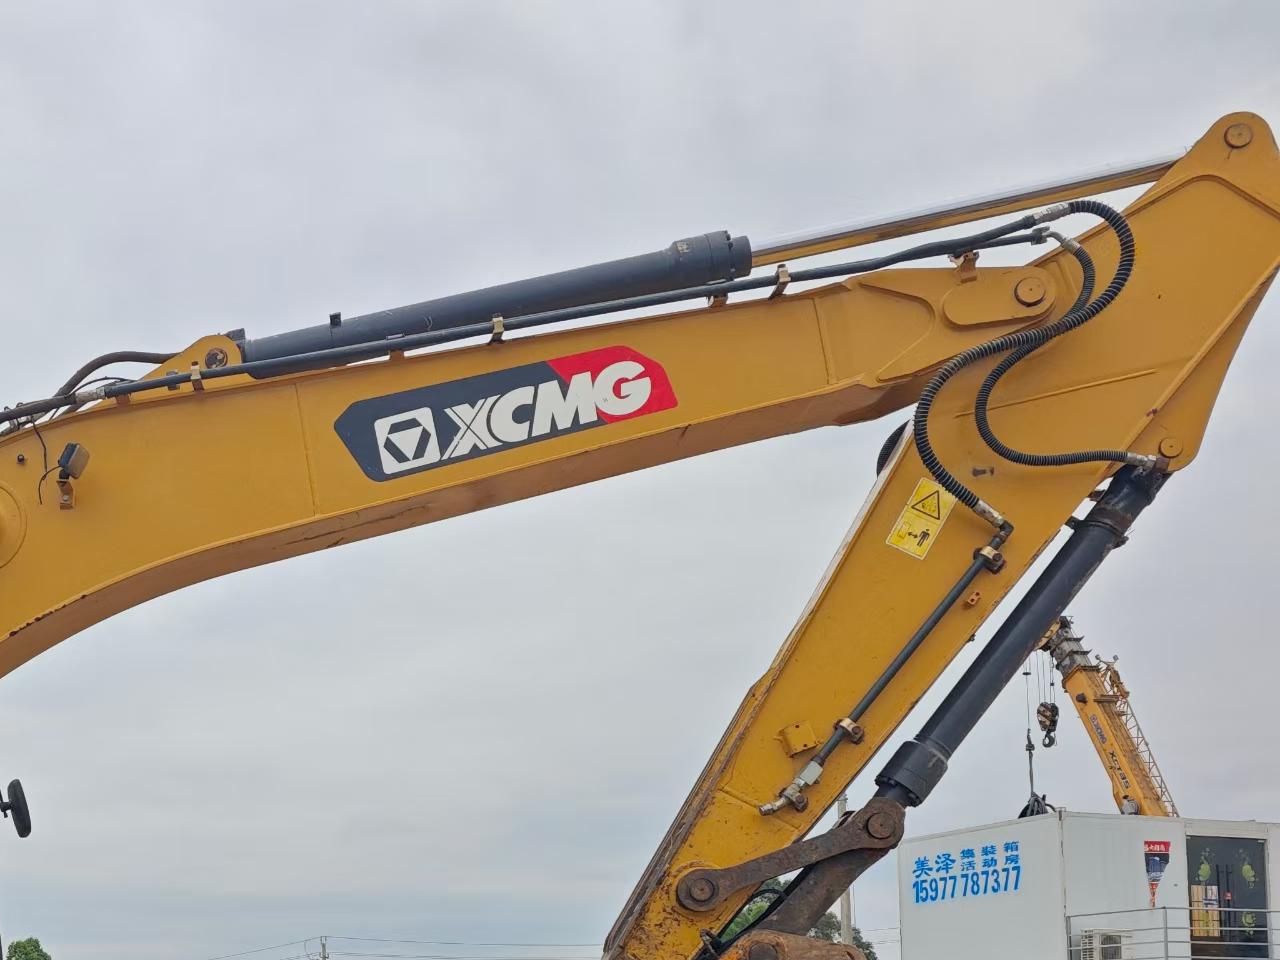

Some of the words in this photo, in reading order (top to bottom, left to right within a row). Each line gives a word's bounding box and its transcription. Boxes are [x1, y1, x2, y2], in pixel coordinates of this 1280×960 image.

[441, 360, 651, 460] XCMG
[960, 841, 1020, 860] 集装箱
[912, 853, 957, 878] 美泽
[961, 854, 1020, 872] 活动房
